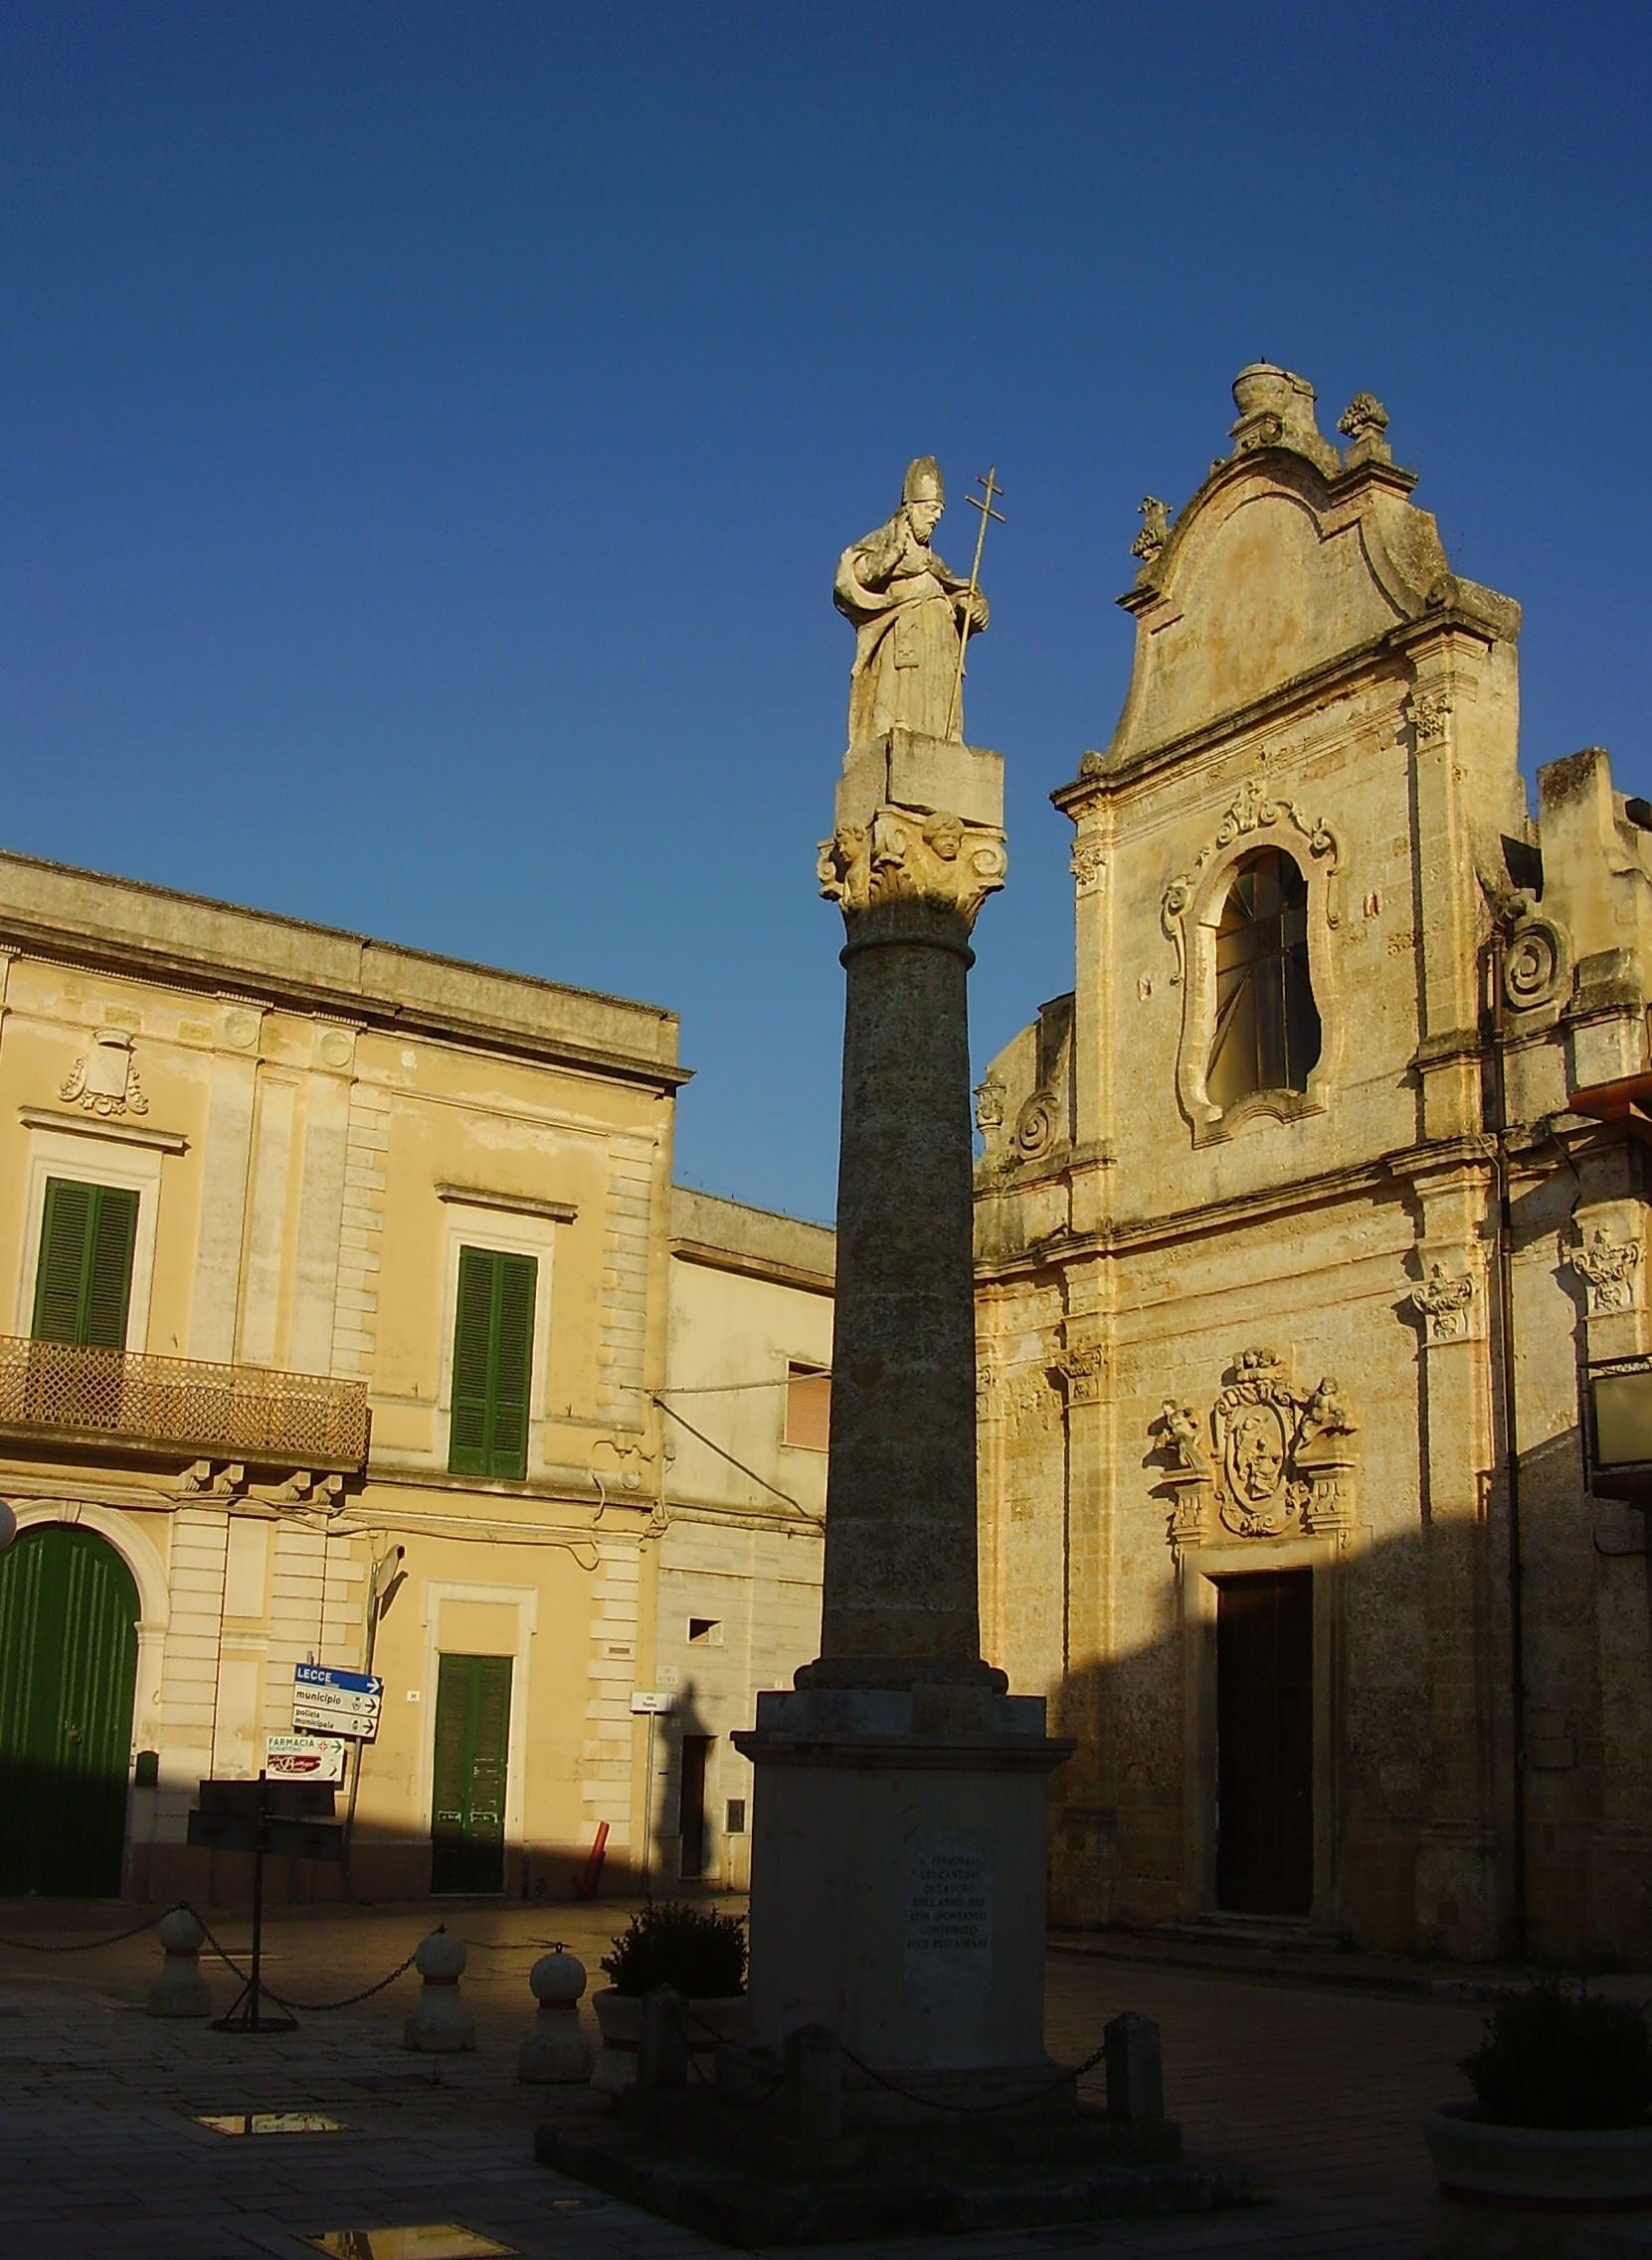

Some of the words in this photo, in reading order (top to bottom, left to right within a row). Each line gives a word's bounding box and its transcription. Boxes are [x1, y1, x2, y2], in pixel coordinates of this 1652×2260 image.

[297, 1667, 332, 1683] LECCE
[296, 1690, 341, 1705] municipio
[295, 1708, 320, 1719] polizia
[294, 1718, 334, 1730] municipale
[269, 1737, 315, 1748] FARMACIA
